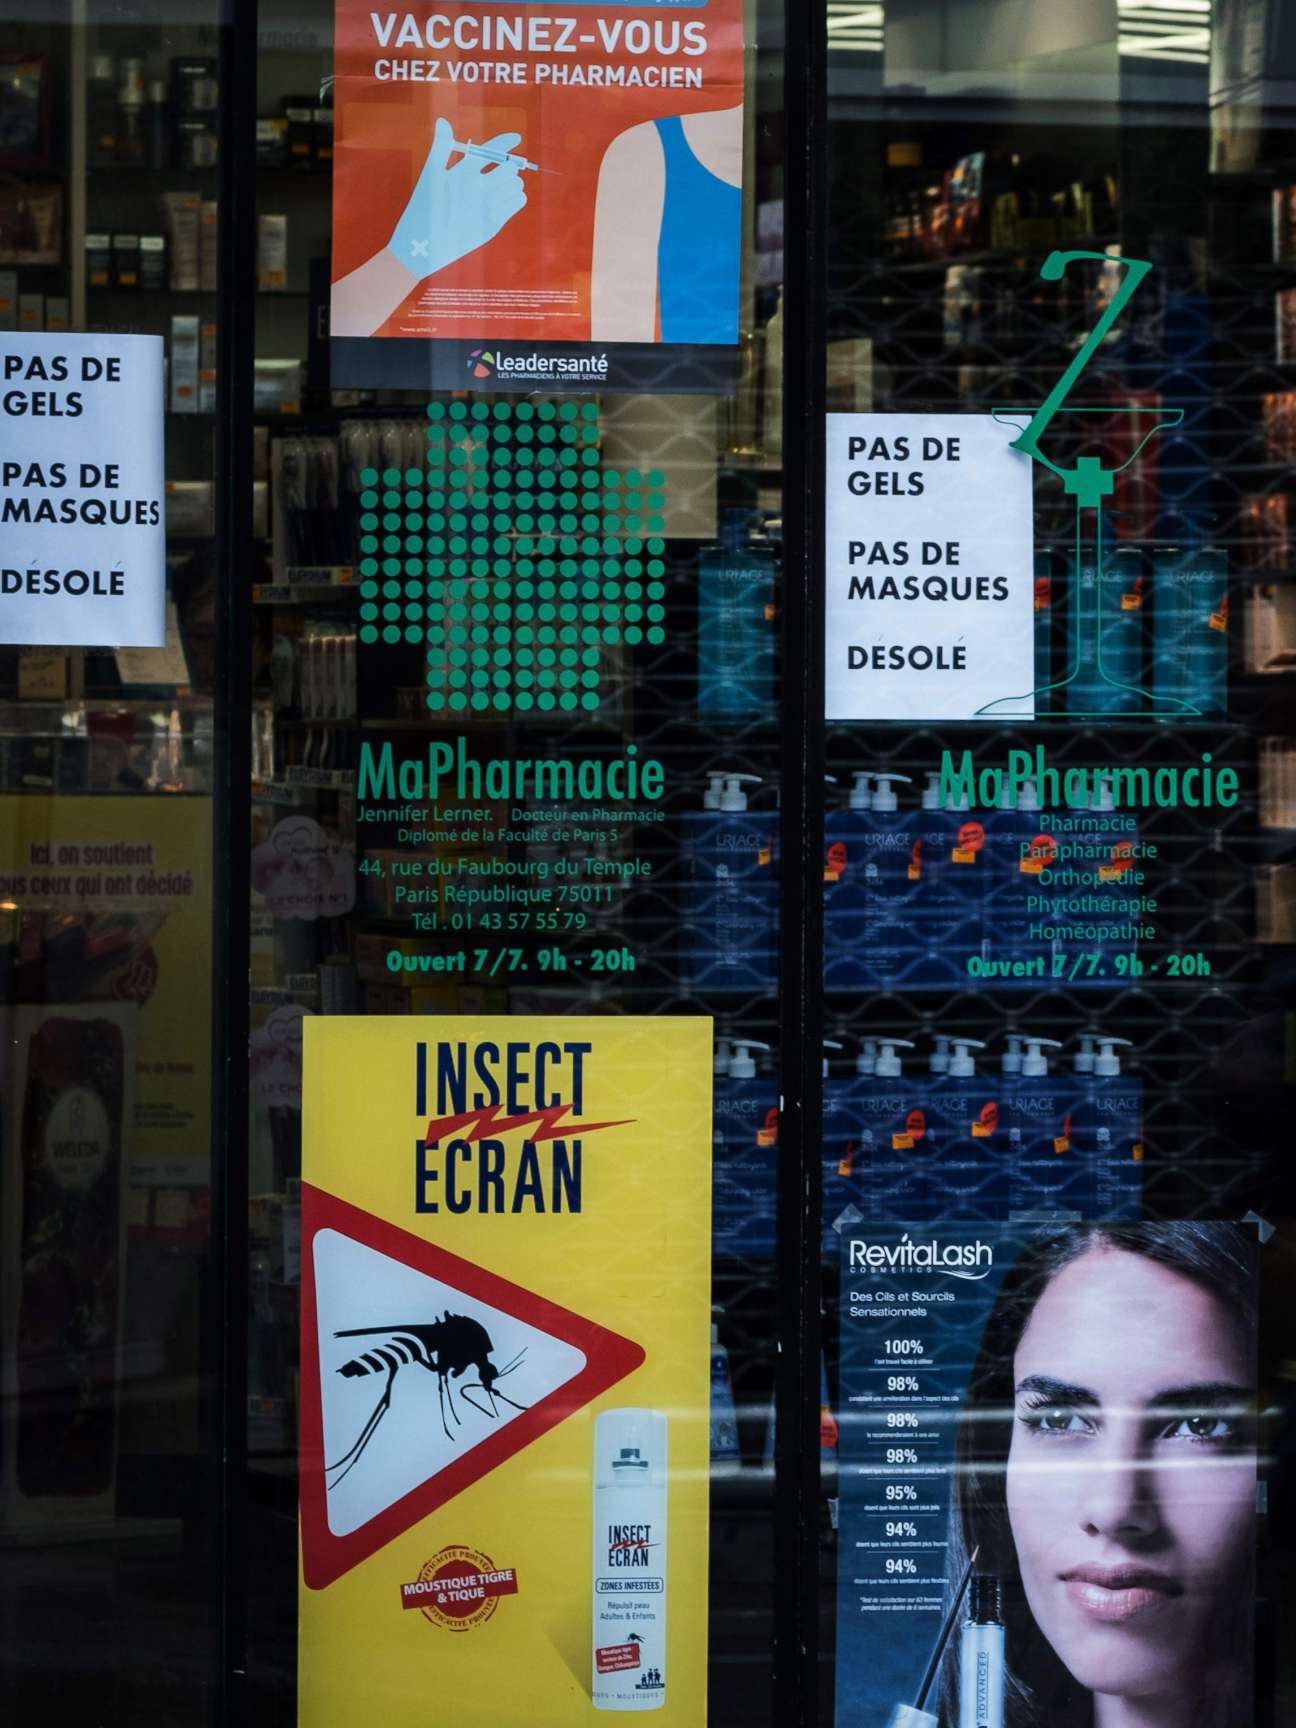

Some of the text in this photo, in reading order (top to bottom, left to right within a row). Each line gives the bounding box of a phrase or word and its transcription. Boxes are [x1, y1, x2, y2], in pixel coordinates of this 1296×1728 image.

[370, 13, 707, 55] VACCINEZ-VOUS
[374, 59, 702, 88] CHEZ VOTRE PHARMACIEN
[4, 356, 121, 382] PAS DE
[2, 391, 83, 417] GELS
[848, 436, 960, 461] PAS DE
[2, 462, 119, 488] PAS DE
[848, 471, 924, 496] GELS
[2, 498, 159, 525] MASQUES
[848, 541, 960, 565] PAS DE
[1, 559, 124, 595] DÉSOLÉ
[848, 576, 1009, 602] MASQUES
[848, 635, 966, 669] DÉSOLÉ
[357, 737, 665, 800] MaPharmacie
[938, 745, 1239, 807] MaPharmacie
[357, 805, 665, 822] Jennifer Lerner. Docteur en Pharmacie
[1039, 814, 1136, 832] Pharmacie
[1020, 841, 1157, 862] Parapharmacie
[359, 858, 652, 879] 44, rue du Faubourg du Temple
[1038, 868, 1144, 889] Orthopédie
[396, 884, 613, 906] Paris République 75011
[1027, 895, 1157, 914] Phytothérapie
[452, 913, 472, 929] 01
[479, 913, 500, 929] 43
[508, 913, 529, 929] 57
[536, 913, 557, 929] 55
[564, 913, 586, 929] 79
[1029, 922, 1155, 942] Homéopathie
[387, 950, 465, 972] Ouvert
[537, 949, 566, 971] 9h
[590, 949, 635, 971] 20h
[967, 955, 1045, 978] Ouvert
[1115, 954, 1143, 976] 9h
[1167, 954, 1210, 976] 20h
[416, 1042, 592, 1117] INSECT
[415, 1139, 582, 1214] ECRAN
[850, 1292, 955, 1302] Des Cils et Sourcils
[850, 1307, 927, 1317] Sensationnels
[885, 1340, 924, 1355] 100%
[887, 1377, 919, 1392] 98%
[887, 1413, 919, 1428] 98%
[886, 1449, 918, 1464] 98%
[886, 1485, 917, 1500] 95%
[609, 1525, 651, 1543] INSECT
[886, 1522, 917, 1537] 94%
[608, 1549, 648, 1567] ECRAN
[886, 1558, 917, 1574] 94%
[404, 1571, 513, 1595] MOUSTIQUE TIGRE
[600, 1581, 660, 1590] ZONES INFESTEES
[437, 1588, 485, 1603] & TIQUE
